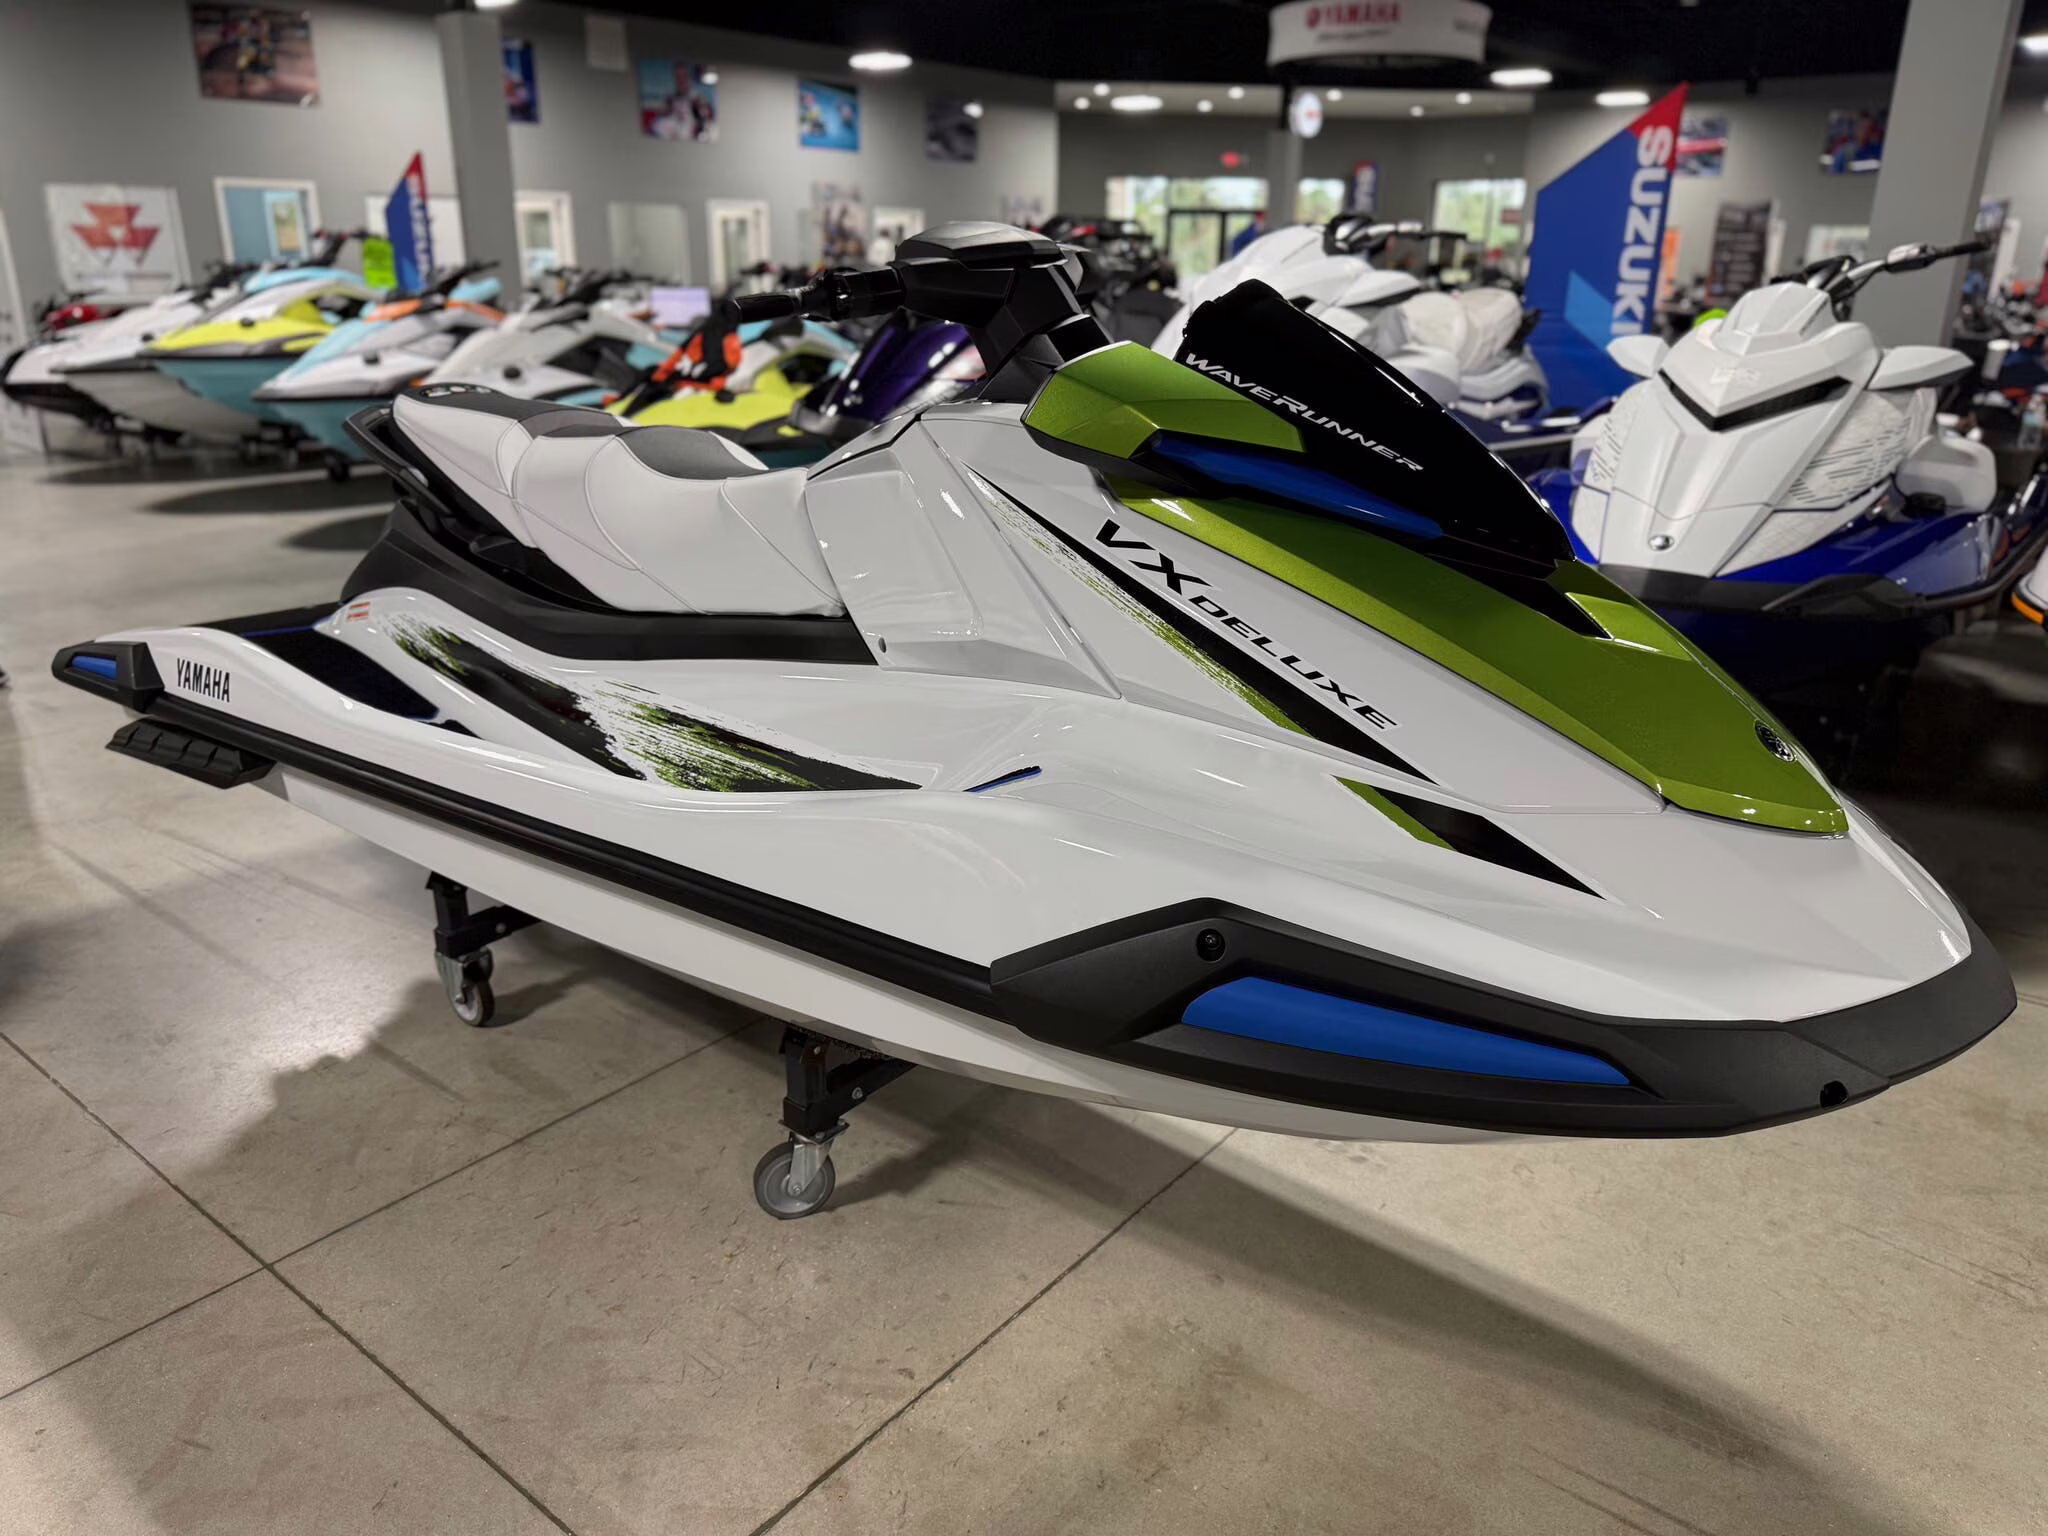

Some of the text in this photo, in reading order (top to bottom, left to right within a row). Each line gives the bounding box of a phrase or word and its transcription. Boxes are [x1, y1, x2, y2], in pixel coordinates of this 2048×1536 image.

[1610, 125, 1674, 335] SUZUKI
[1185, 353, 1424, 471] WAVERUNNER
[177, 657, 230, 703] YAMAHA
[1095, 518, 1398, 730] VX DELUXE
